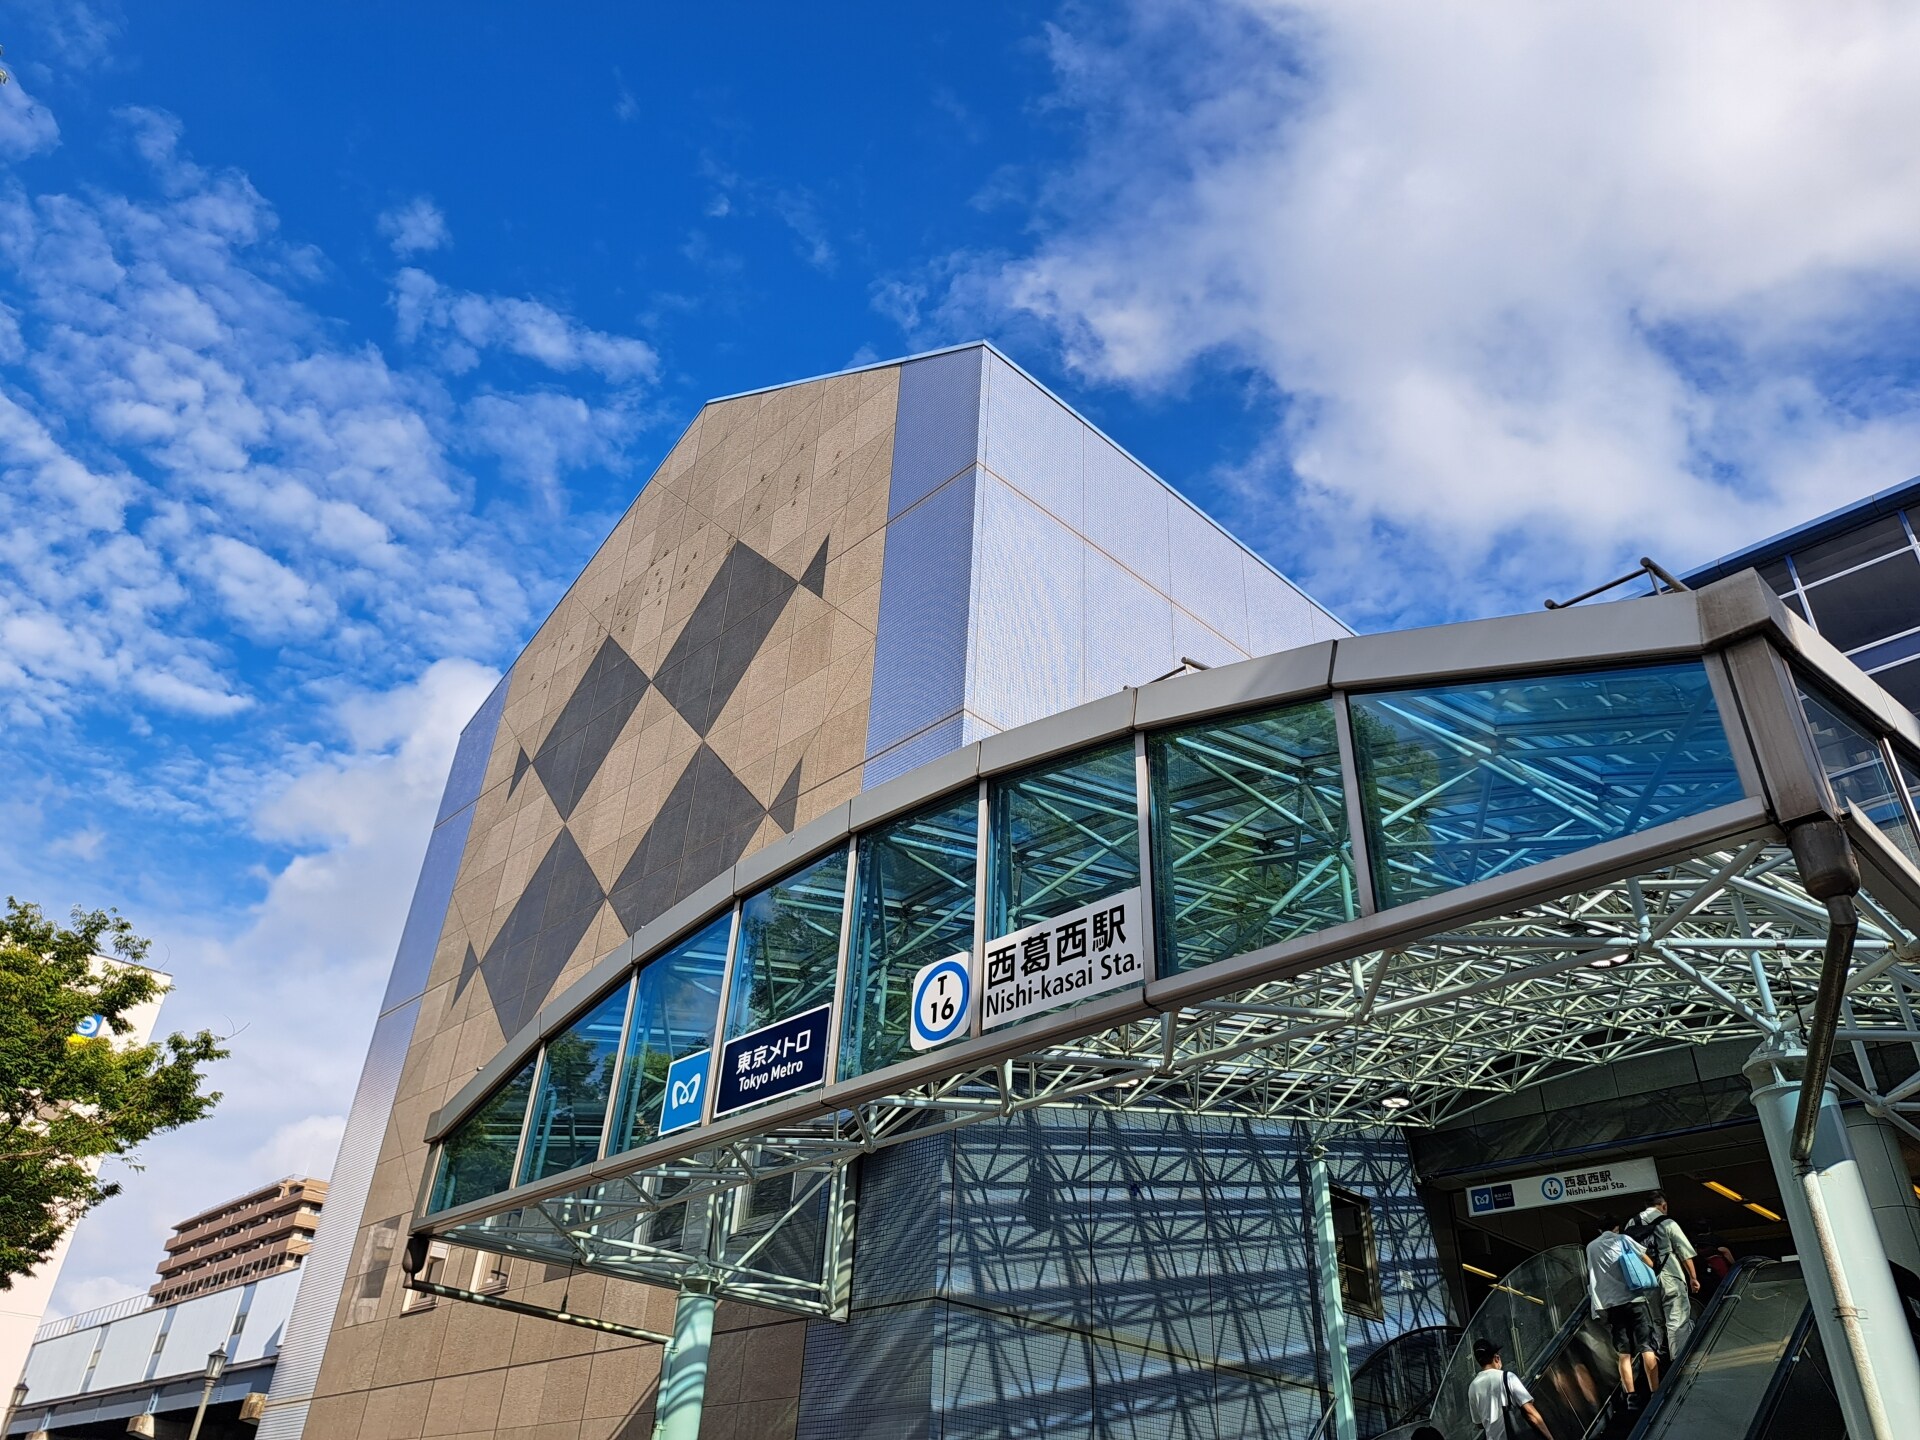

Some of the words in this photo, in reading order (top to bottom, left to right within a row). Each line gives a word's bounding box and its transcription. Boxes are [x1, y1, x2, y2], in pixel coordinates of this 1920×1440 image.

[987, 904, 1127, 990] 西葛西駅
[937, 975, 948, 996] T
[986, 959, 1093, 1018] Nishi-kasai
[1100, 952, 1142, 981] Sta.
[930, 997, 955, 1024] 16
[736, 1029, 811, 1075] 東京メトロ
[739, 1073, 768, 1092] Tokyo
[771, 1060, 803, 1081] Metro
[1548, 1188, 1559, 1196] 16
[1564, 1170, 1612, 1188] 西葛西駅
[1565, 1183, 1609, 1196] Nishi-kasai
[1611, 1182, 1627, 1190] Sta.
